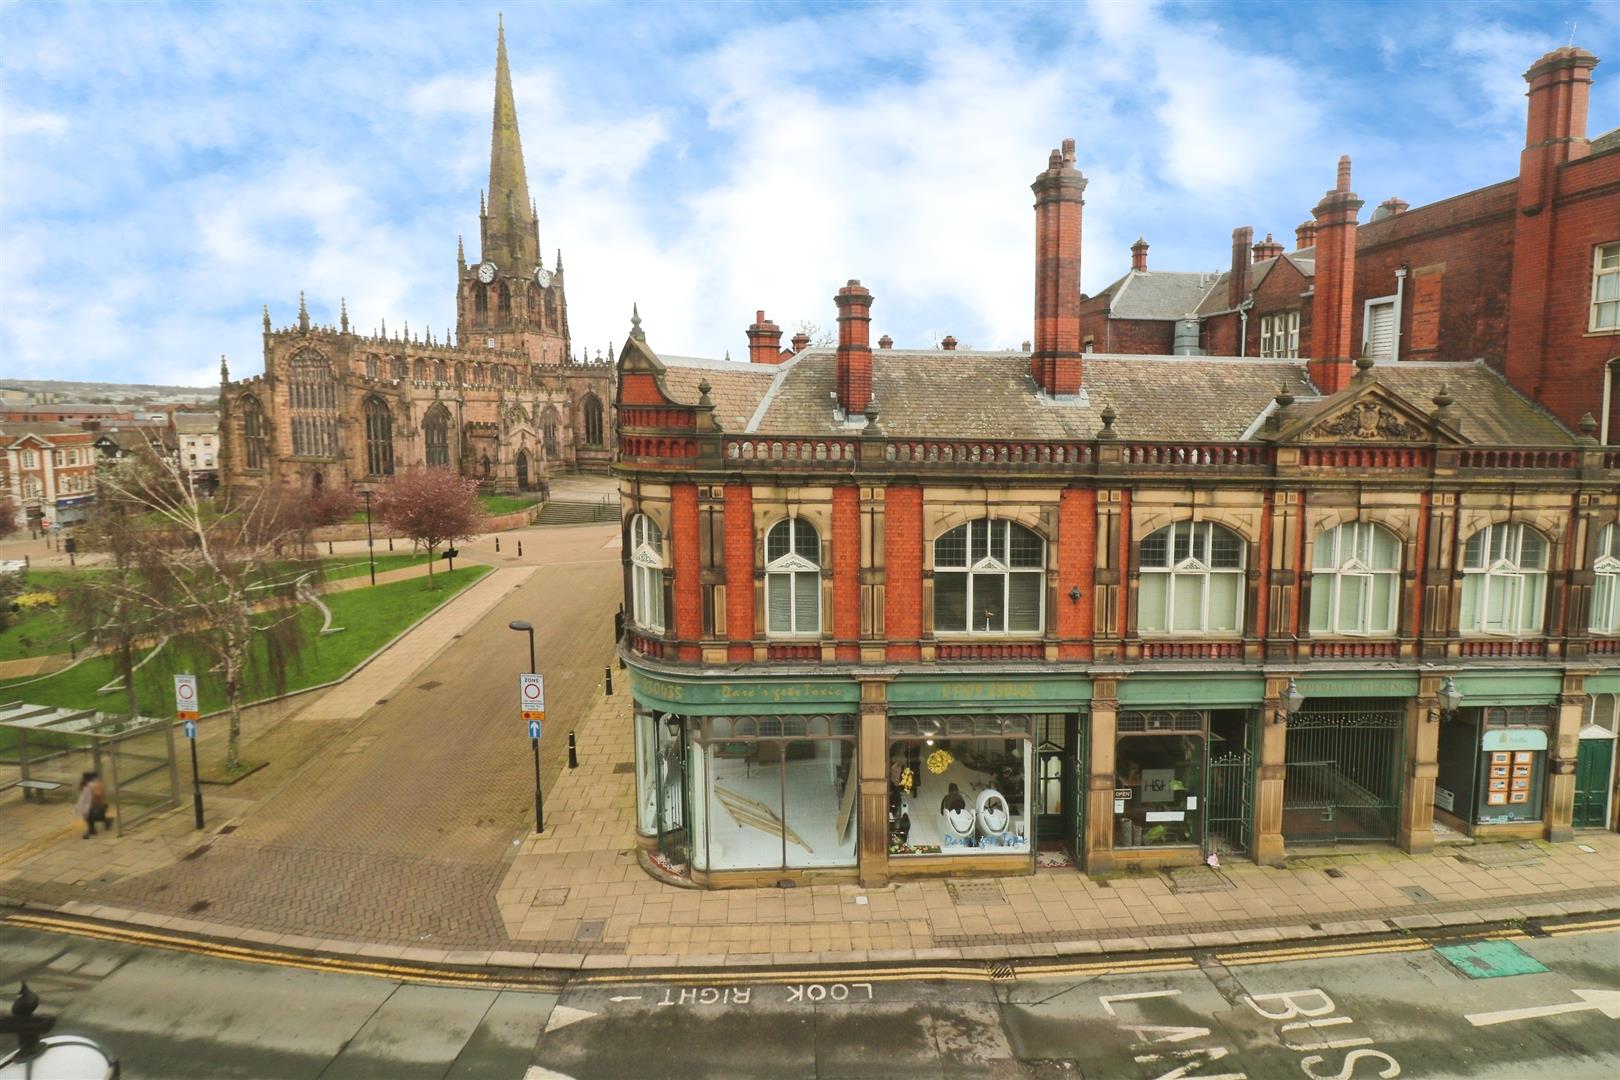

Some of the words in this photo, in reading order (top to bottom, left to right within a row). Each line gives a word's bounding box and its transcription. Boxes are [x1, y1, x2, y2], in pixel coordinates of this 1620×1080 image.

[658, 987, 750, 1006] RIGHT
[787, 983, 872, 1001] LOOK
[1243, 988, 1401, 1080] BUS
